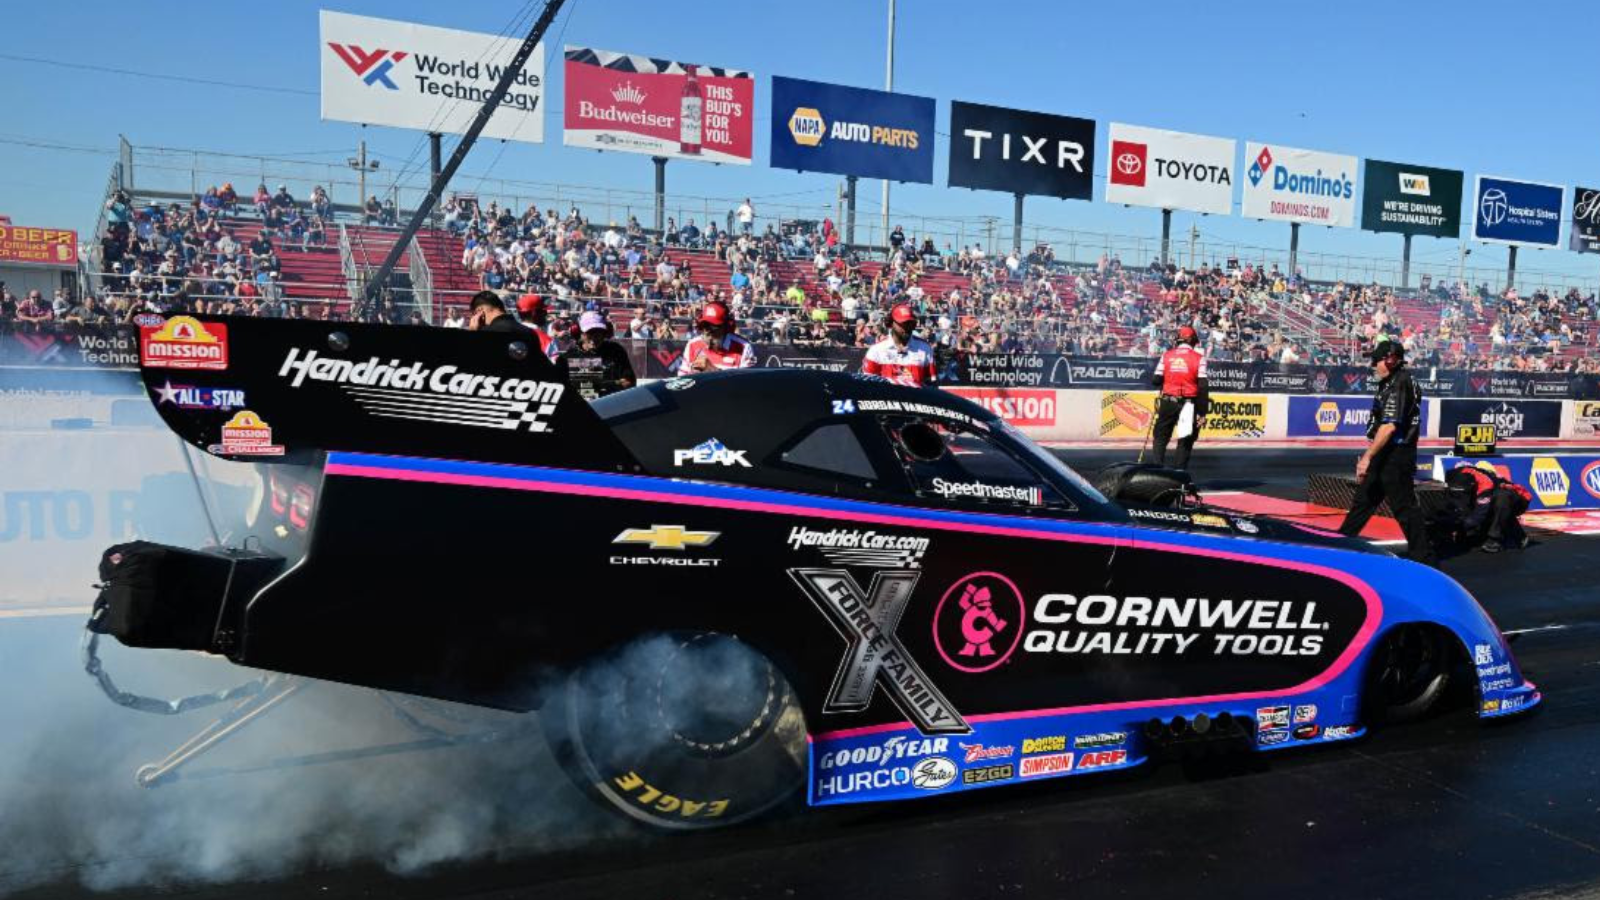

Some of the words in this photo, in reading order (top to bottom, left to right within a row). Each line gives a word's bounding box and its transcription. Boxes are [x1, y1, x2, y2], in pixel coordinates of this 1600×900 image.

[414, 53, 479, 80] World
[486, 63, 540, 88] Wde
[414, 74, 540, 111] Technoogy
[705, 84, 733, 101] THIS
[578, 100, 676, 128] Budweiser
[705, 100, 742, 117] BUD'S
[705, 114, 730, 129] FOR
[793, 116, 821, 136] NAPA
[705, 128, 733, 145] YOU.
[830, 120, 870, 143] AUTO
[871, 126, 919, 149] PARTS
[964, 128, 1084, 173] TIXR
[1154, 157, 1231, 186] TOYOTA
[1273, 165, 1353, 200] Domino's
[1402, 178, 1427, 191] WM
[1270, 200, 1331, 220] DOMINOS.COM
[1383, 200, 1409, 213] WE'RE
[1410, 202, 1443, 215] DRIVING
[1508, 205, 1535, 218] Hospital
[1536, 208, 1559, 220] Sisters
[1381, 211, 1443, 226] SUSTAINABILITY
[968, 354, 1007, 368] World
[1014, 354, 1044, 368] Wide
[278, 347, 565, 404] HendrickCars.com
[968, 368, 1043, 385] Technology
[1072, 366, 1146, 379] RACEWAY
[1228, 369, 1248, 379] Wide
[1263, 376, 1308, 386] RACEWAY
[179, 388, 204, 405] ALL
[212, 390, 245, 407] STAR
[832, 399, 854, 413] 24
[857, 399, 902, 411] JORDAN
[1481, 413, 1524, 431] BUSCH
[674, 448, 753, 467] PEAK
[932, 477, 1029, 500] Speedmaster
[1535, 471, 1566, 492] NAPA
[786, 526, 930, 551] HendrickCars.com
[609, 555, 723, 567] CHEVROLET
[825, 580, 888, 655] FORCE
[1023, 630, 1200, 655] QUALITY
[1213, 634, 1324, 656] TOOLS
[880, 648, 951, 725] FAMILY
[820, 736, 949, 769] GOODYEAR
[1079, 750, 1127, 767] ARP
[1022, 754, 1071, 775] SIMPSON
[818, 766, 910, 796] HURCO
[614, 771, 731, 817] EAGLE
